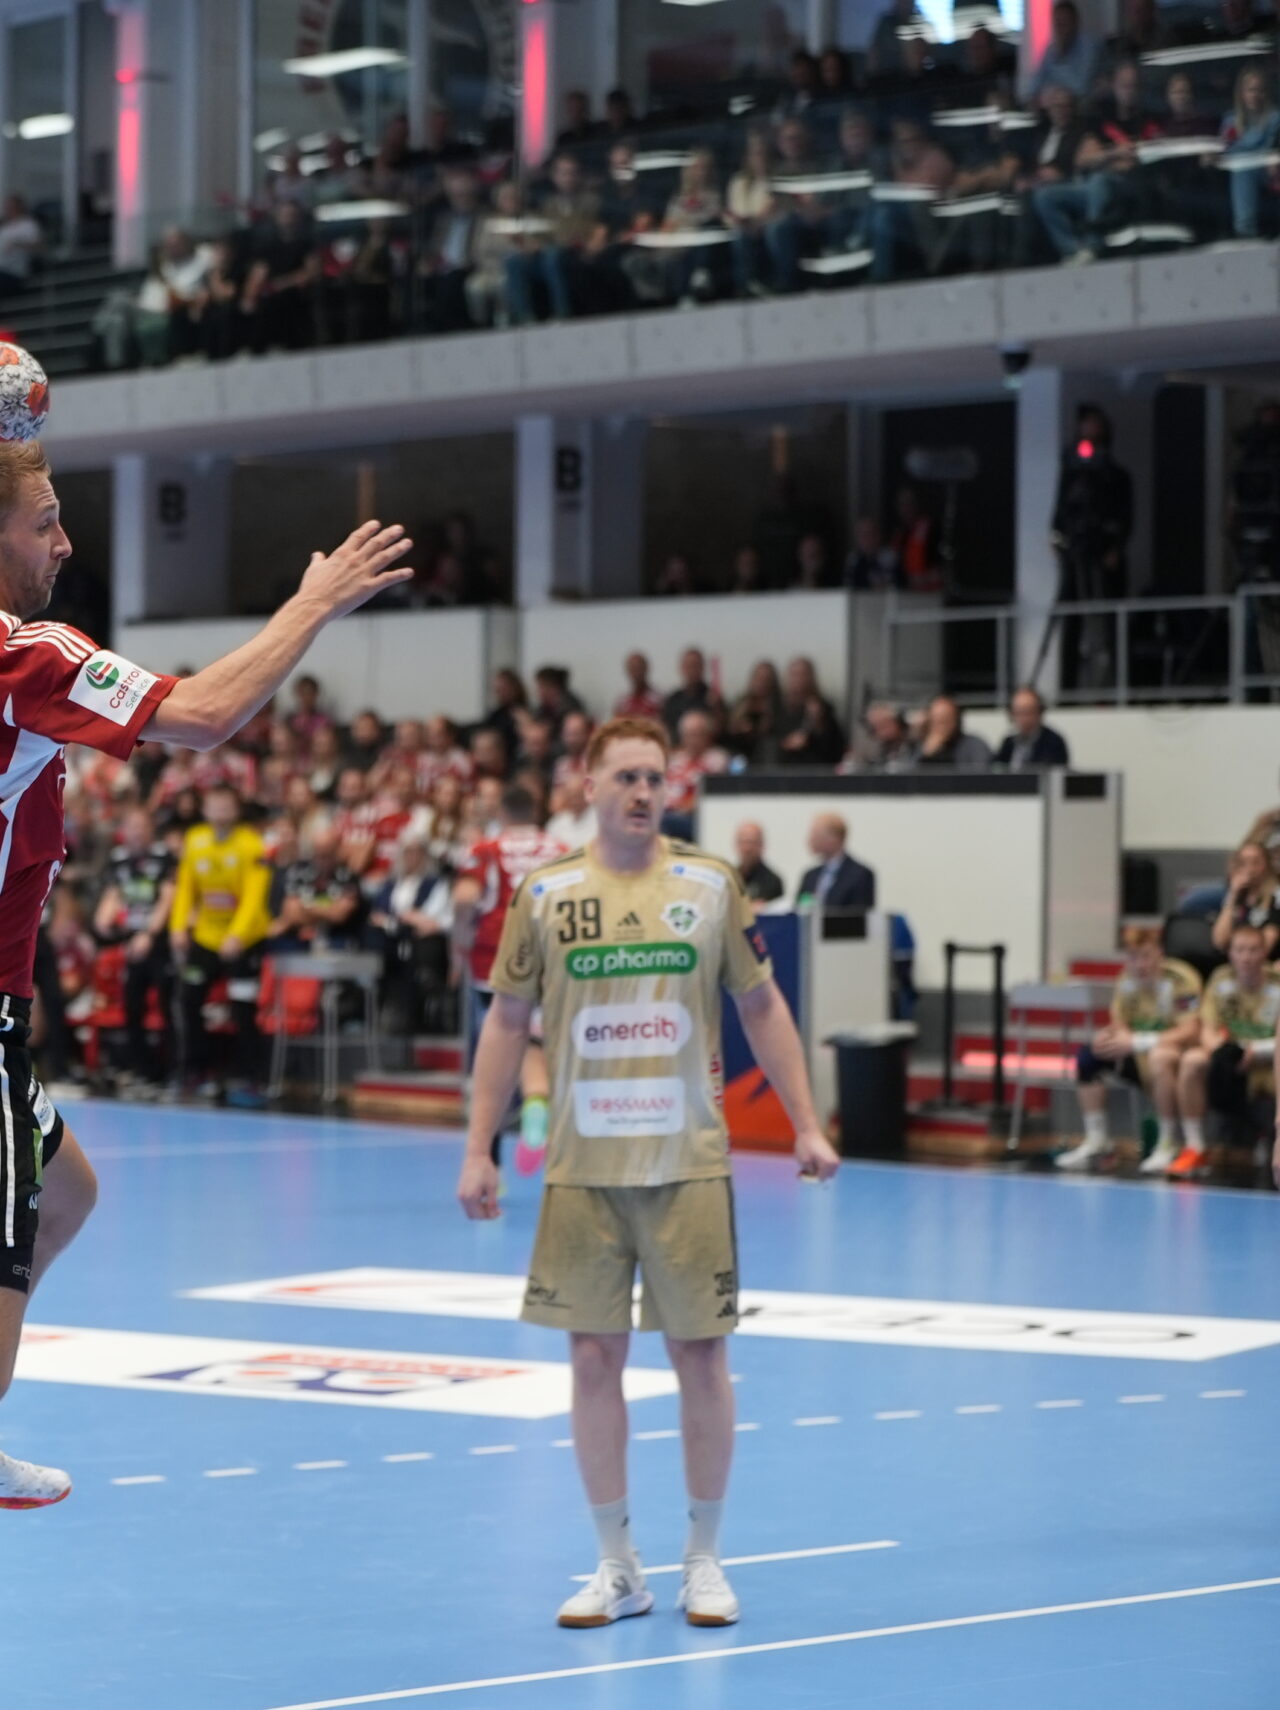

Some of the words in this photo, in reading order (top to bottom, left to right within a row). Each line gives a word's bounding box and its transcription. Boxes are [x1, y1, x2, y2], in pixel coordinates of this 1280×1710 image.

[109, 667, 142, 709] Castrol
[557, 898, 602, 944] 39
[573, 956, 600, 975] cp
[604, 948, 691, 974] pharma
